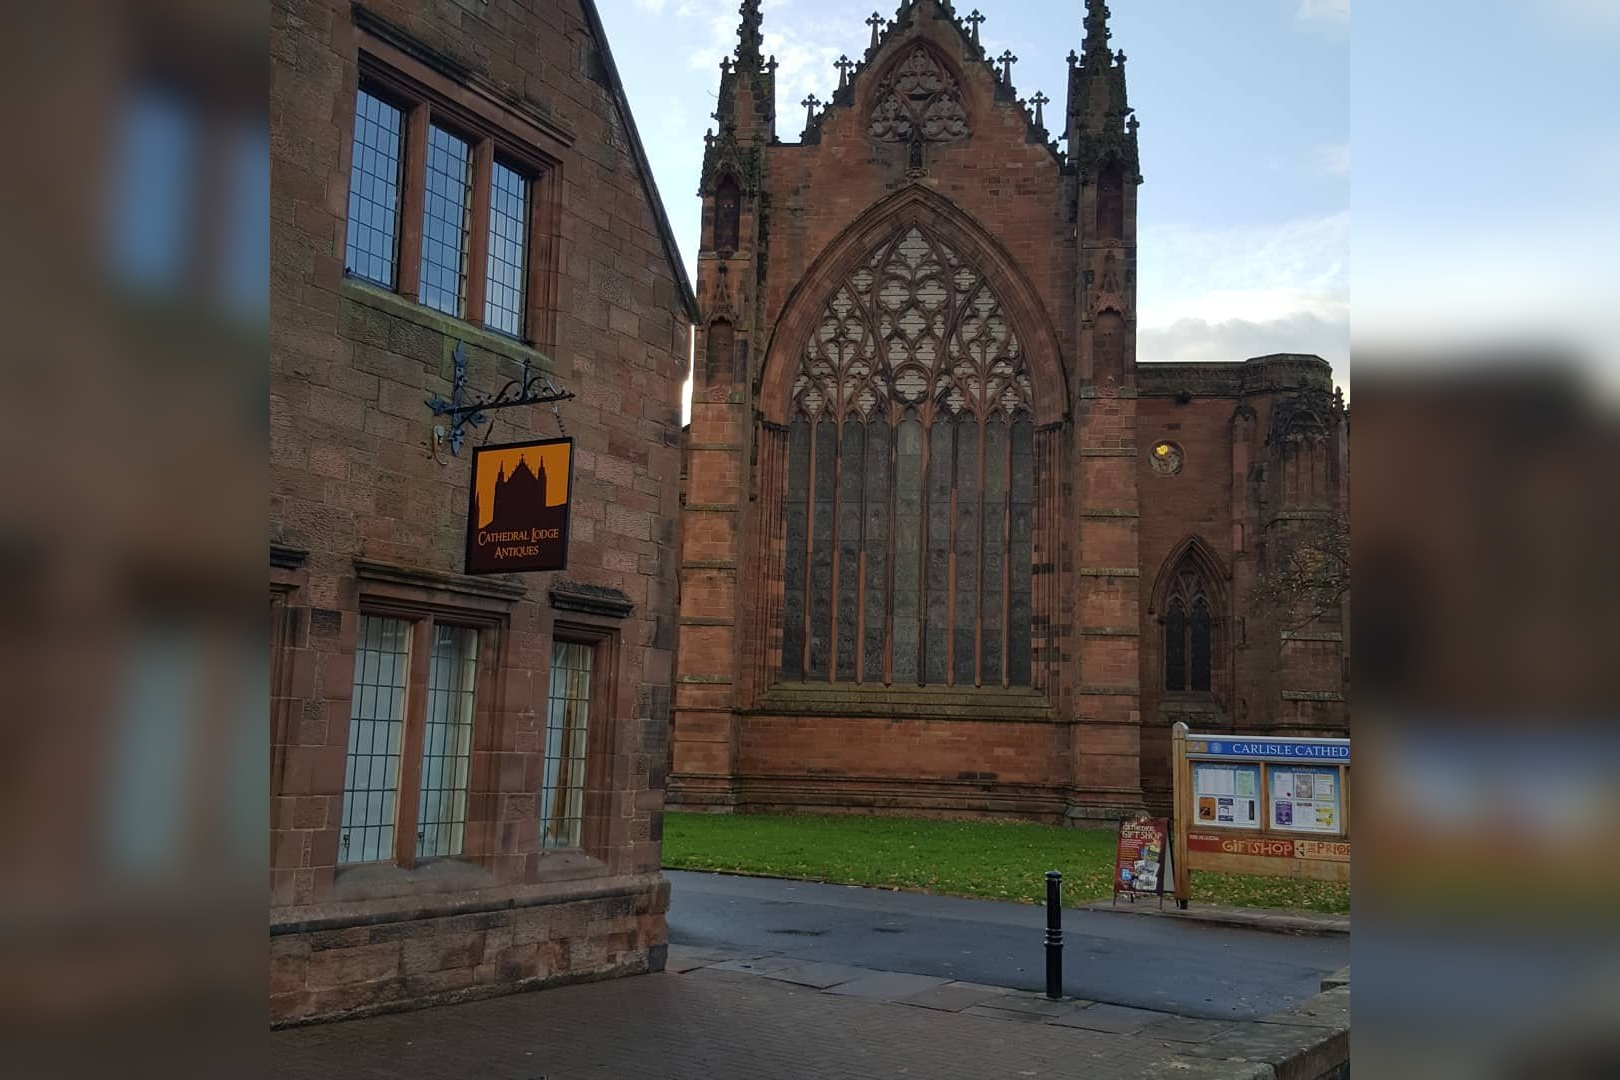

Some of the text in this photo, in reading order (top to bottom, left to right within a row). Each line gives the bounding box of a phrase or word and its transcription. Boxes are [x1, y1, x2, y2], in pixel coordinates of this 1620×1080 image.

[478, 528, 559, 546] CATHEDRAL LODGE
[494, 545, 540, 560] ANTIQUES
[1232, 743, 1350, 757] CARLISLE CATHED
[1140, 831, 1162, 840] SHOP
